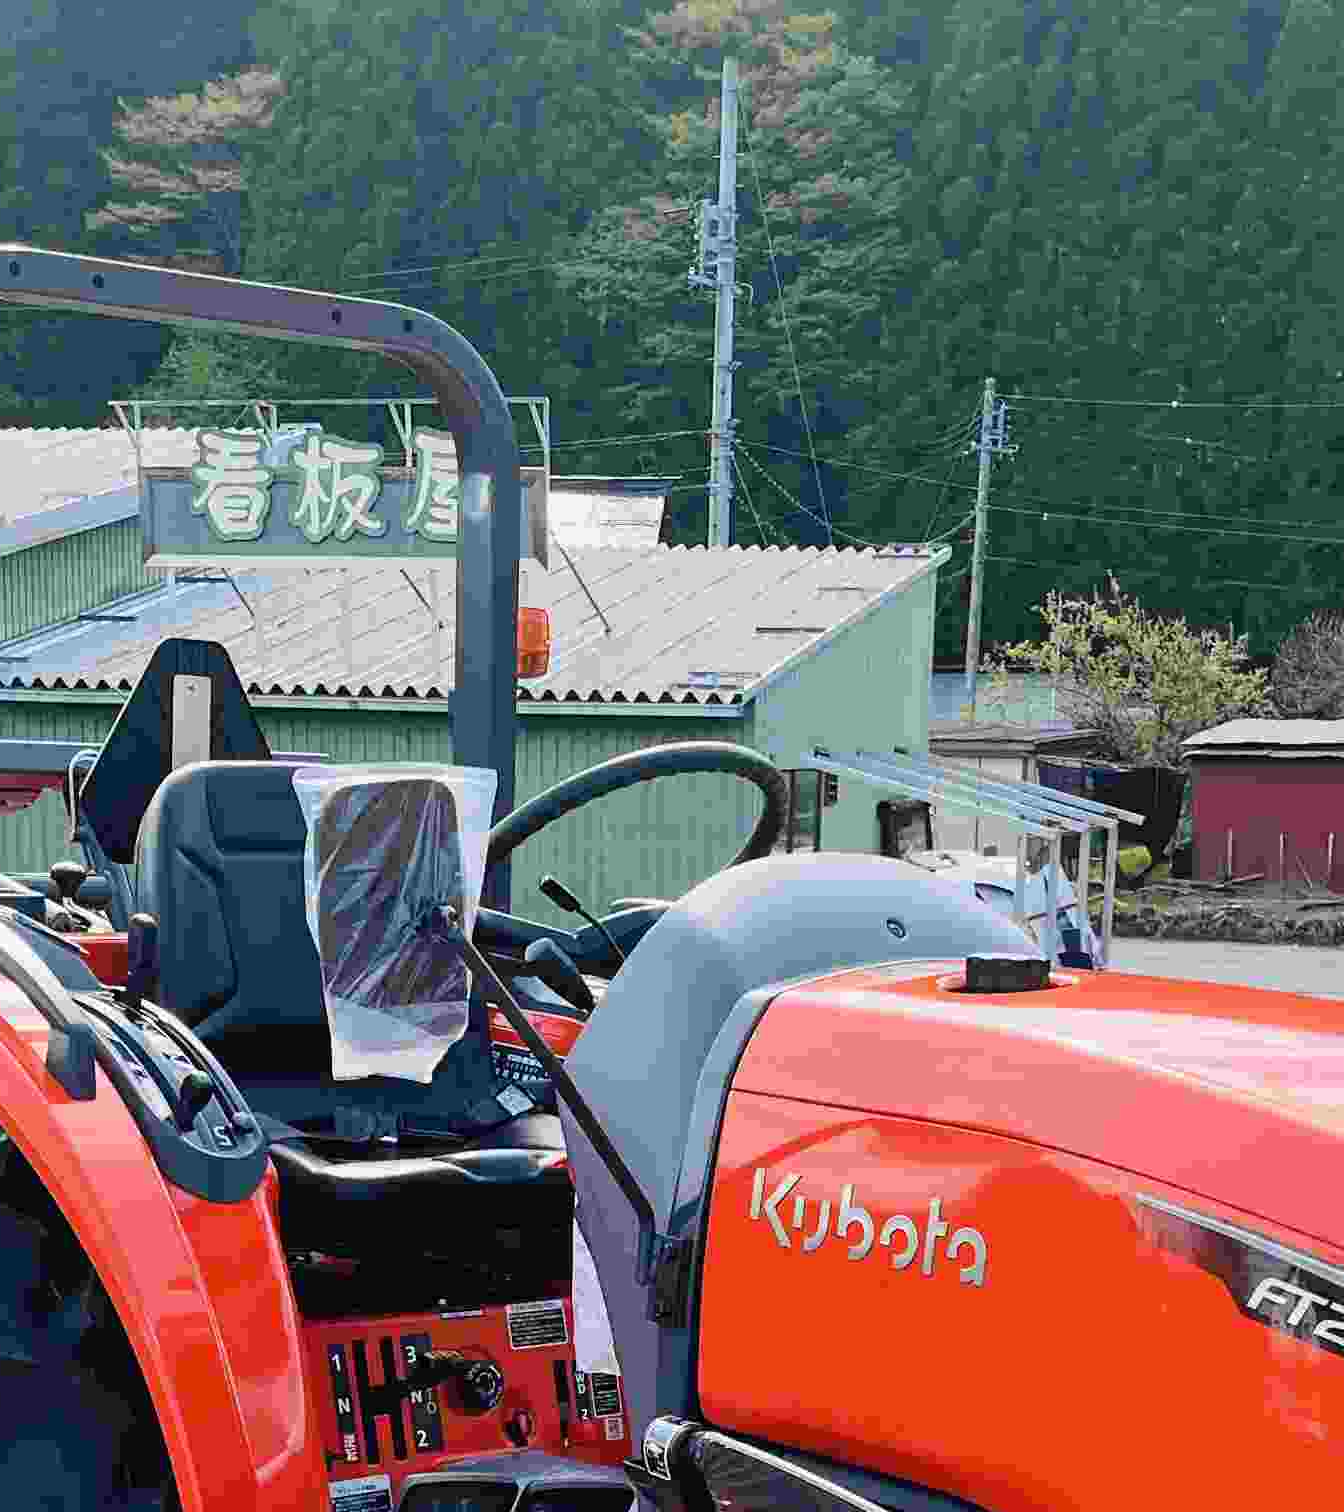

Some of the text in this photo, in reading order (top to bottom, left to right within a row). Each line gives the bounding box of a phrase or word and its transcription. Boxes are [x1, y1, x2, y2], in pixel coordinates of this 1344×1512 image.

[748, 1167, 988, 1288] Kubota
[337, 1397, 352, 1415] N
[416, 1429, 430, 1447] 2
